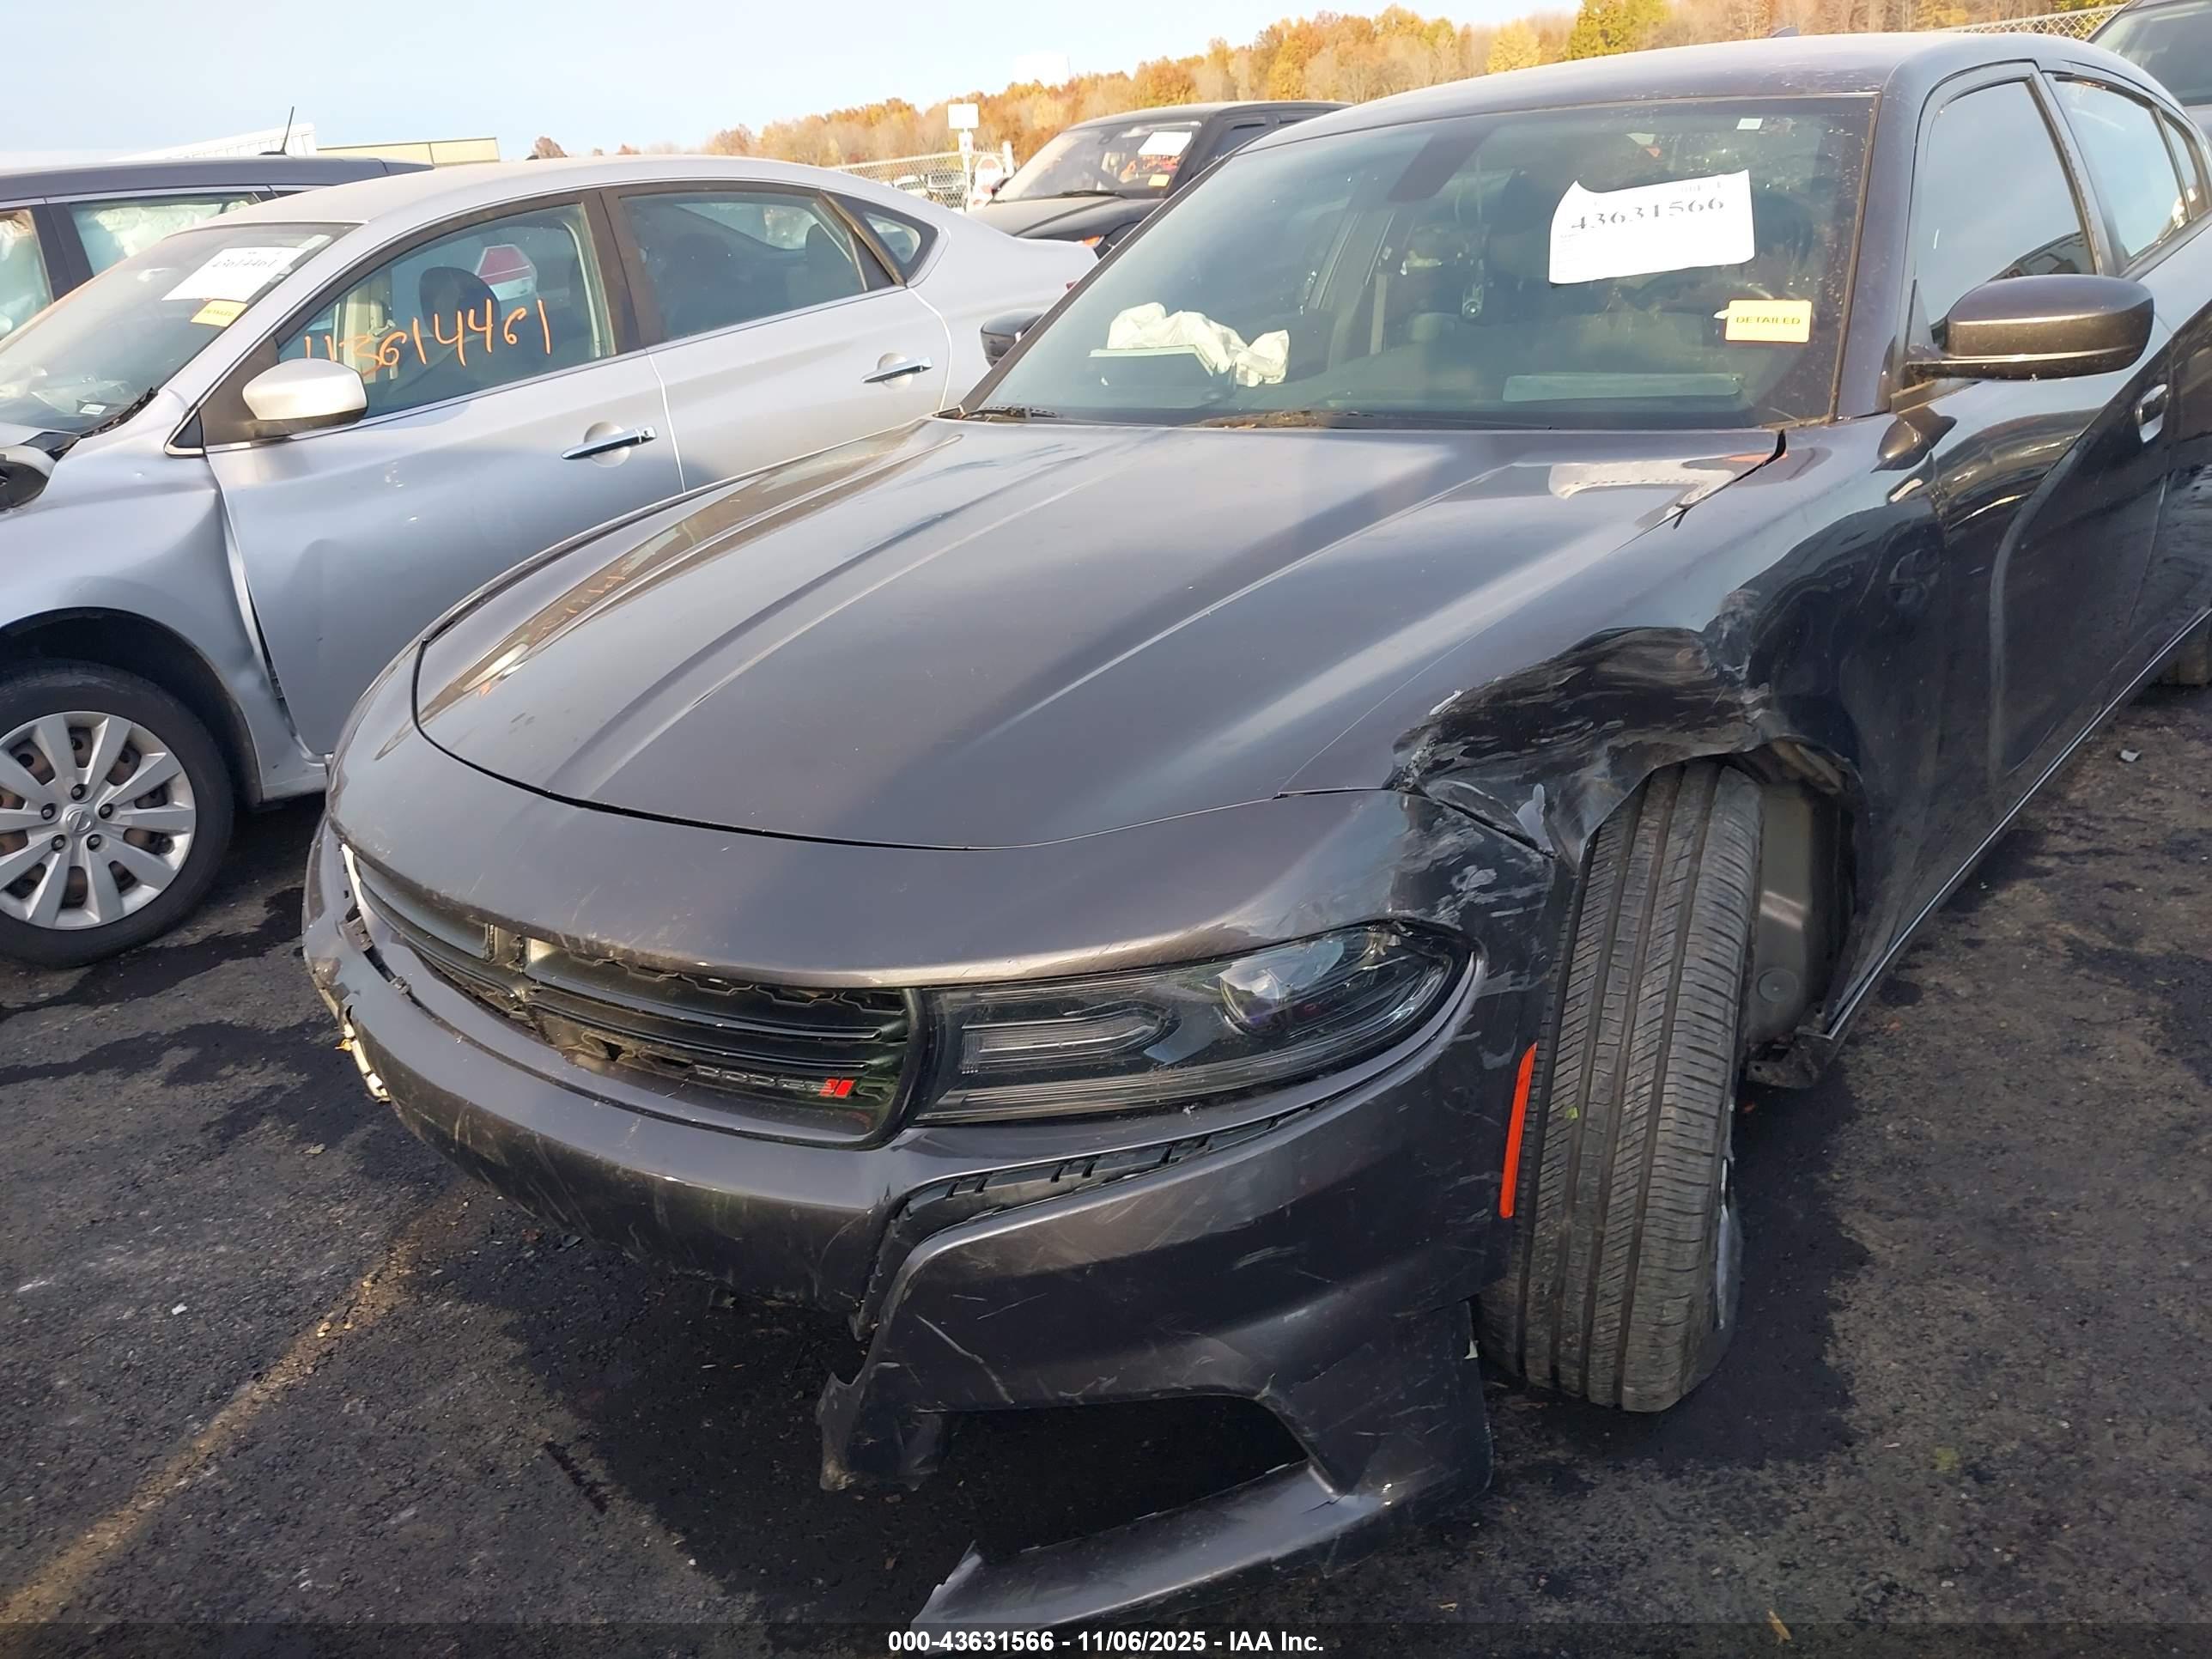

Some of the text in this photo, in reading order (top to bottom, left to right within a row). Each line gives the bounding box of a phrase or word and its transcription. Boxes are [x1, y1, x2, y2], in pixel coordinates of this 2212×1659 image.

[1569, 197, 1725, 230] 43631566
[1735, 316, 1801, 325] DETAILED
[694, 1064, 835, 1094] DODGE
